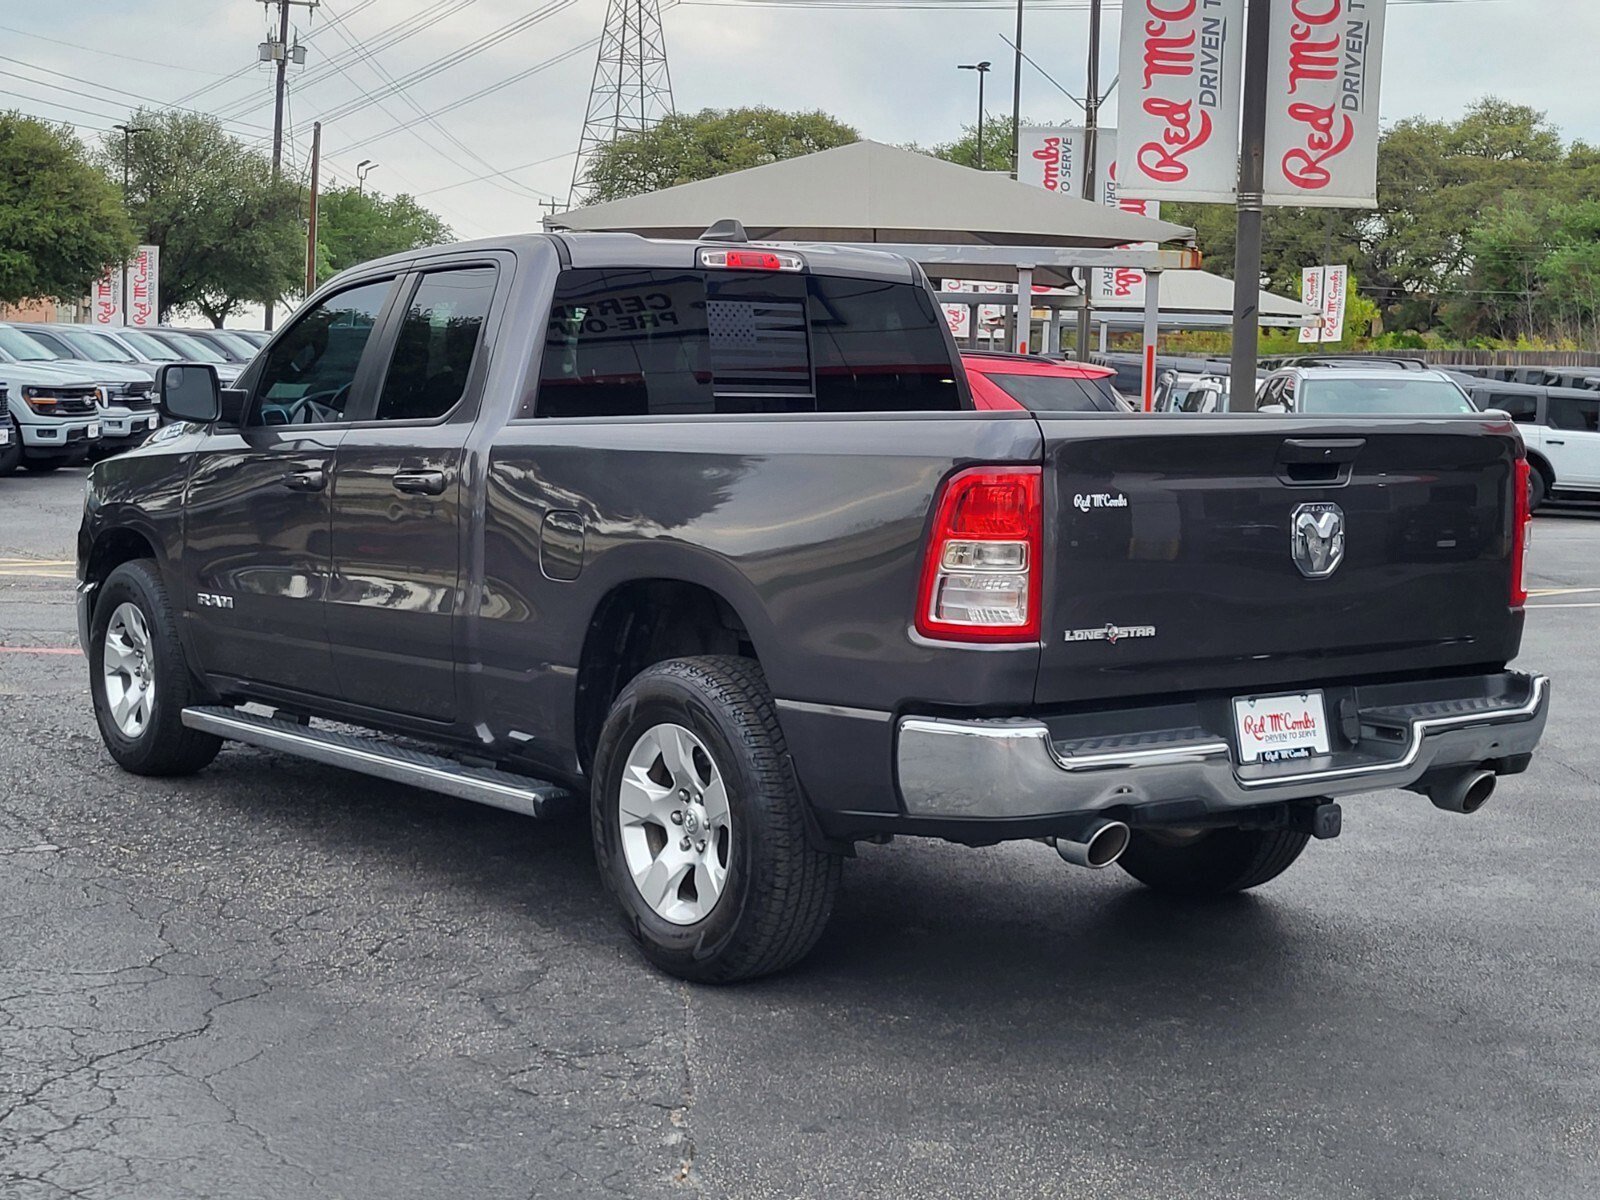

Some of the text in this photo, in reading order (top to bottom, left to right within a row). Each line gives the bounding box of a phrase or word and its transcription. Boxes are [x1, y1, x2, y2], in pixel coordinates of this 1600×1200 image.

[1199, 0, 1221, 107] DRIVEN T
[1342, 0, 1365, 111] DRIVEN T
[1137, 0, 1212, 182] Red McC
[1282, 0, 1354, 189] Red McC
[1032, 137, 1060, 191] ombs
[1060, 137, 1072, 194] O SERVE
[97, 301, 116, 324] Red
[133, 302, 151, 325] Red
[1073, 493, 1127, 512] Red McCombs
[197, 593, 233, 609] RAM
[1064, 626, 1156, 641] LONE STAR
[1243, 711, 1315, 741] Red McCombs
[1265, 733, 1288, 742] DRIVEN
[1298, 730, 1317, 739] SERVE
